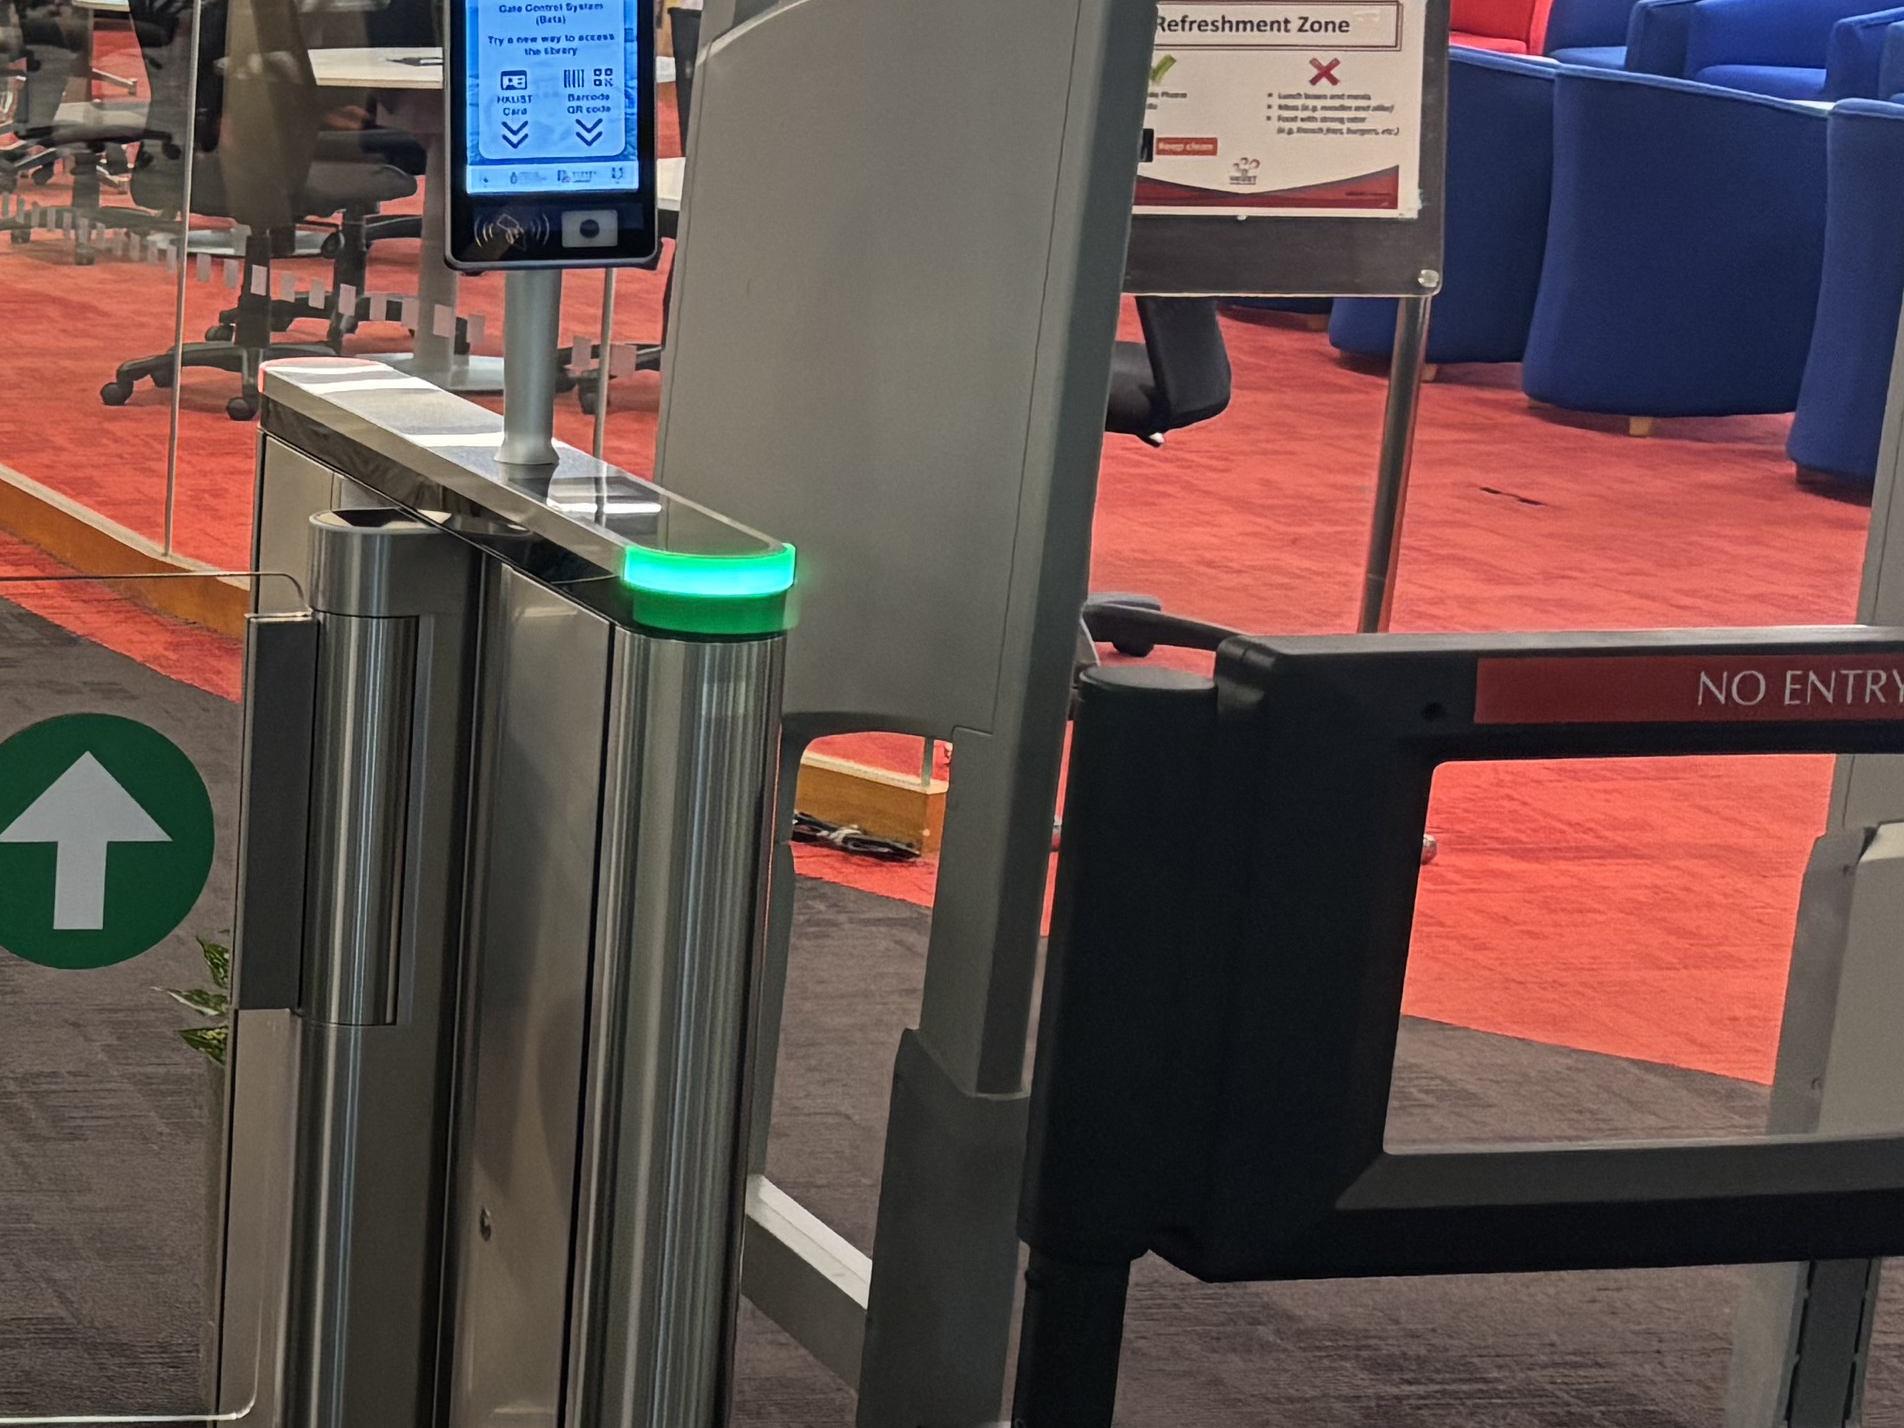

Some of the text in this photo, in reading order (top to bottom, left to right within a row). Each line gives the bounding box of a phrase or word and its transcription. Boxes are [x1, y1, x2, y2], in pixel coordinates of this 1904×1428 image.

[525, 3, 563, 13] Control
[565, 2, 604, 14] System
[1156, 15, 1350, 33] Refreshment Zone
[488, 35, 504, 47] Try
[564, 34, 576, 43] to
[578, 33, 615, 42] access
[567, 105, 611, 115] QR code
[1698, 669, 1766, 707] NO
